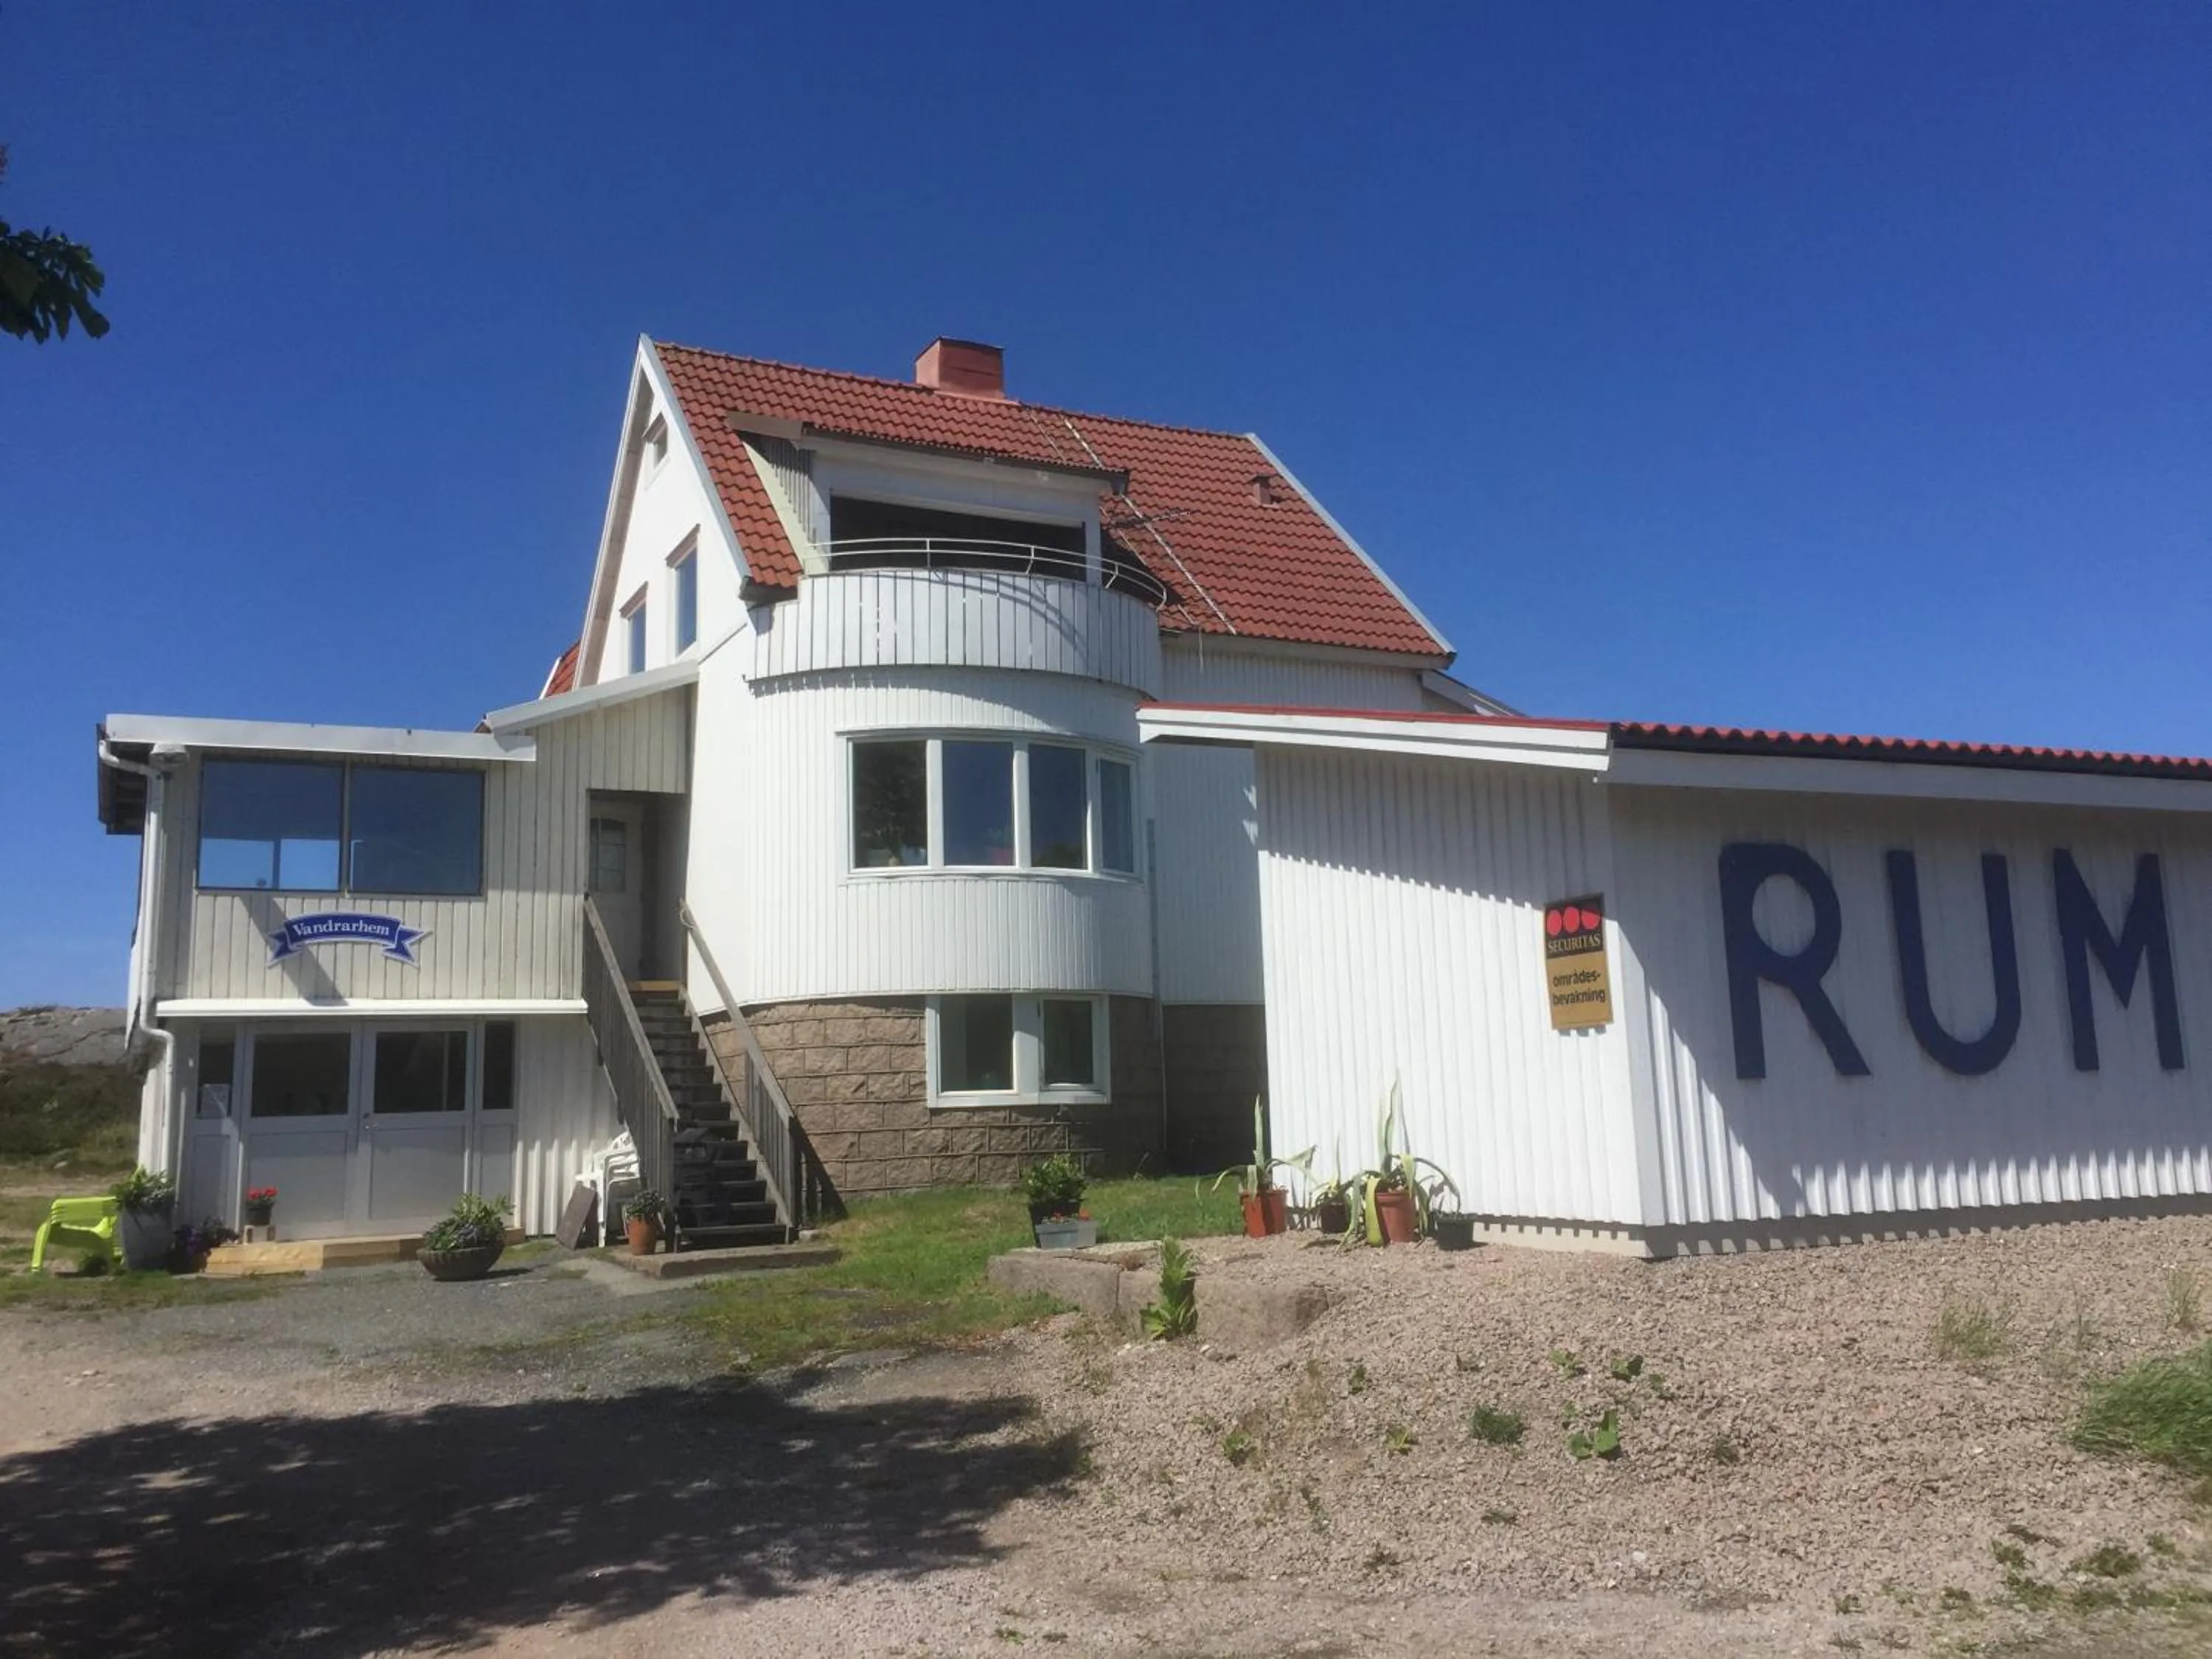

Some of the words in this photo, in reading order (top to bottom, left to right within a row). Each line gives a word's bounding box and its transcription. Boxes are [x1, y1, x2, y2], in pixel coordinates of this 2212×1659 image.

[293, 919, 390, 936] Vandrarhem
[1548, 934, 1601, 953] SECURITAS
[1718, 843, 2185, 1079] RUM
[1553, 969, 1601, 987] områdes-
[1553, 988, 1606, 1005] bevakning
